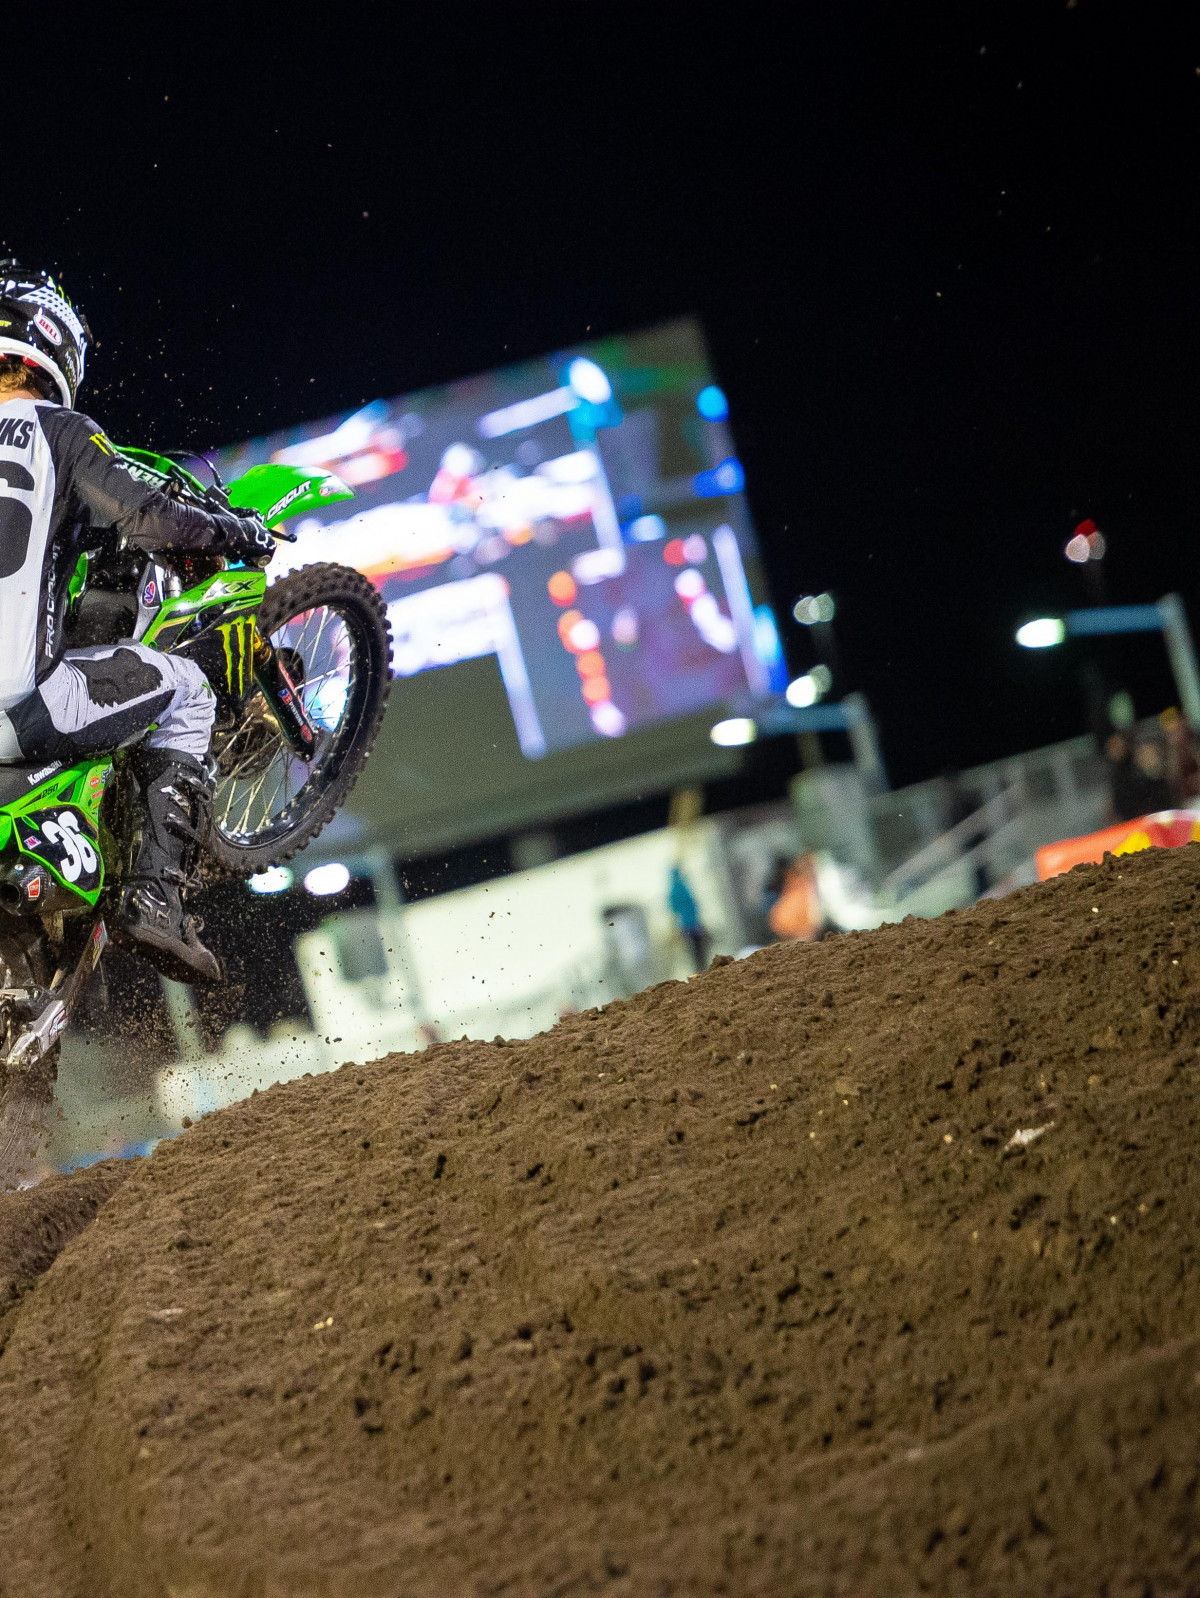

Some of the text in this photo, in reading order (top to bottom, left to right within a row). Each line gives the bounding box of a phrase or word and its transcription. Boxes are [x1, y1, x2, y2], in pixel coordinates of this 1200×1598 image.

[39, 318, 59, 341] BELL
[266, 480, 311, 521] CIRCUIT
[45, 614, 55, 659] PRO
[27, 760, 63, 786] Kawasaki
[42, 783, 59, 799] 250
[41, 811, 97, 883] 36
